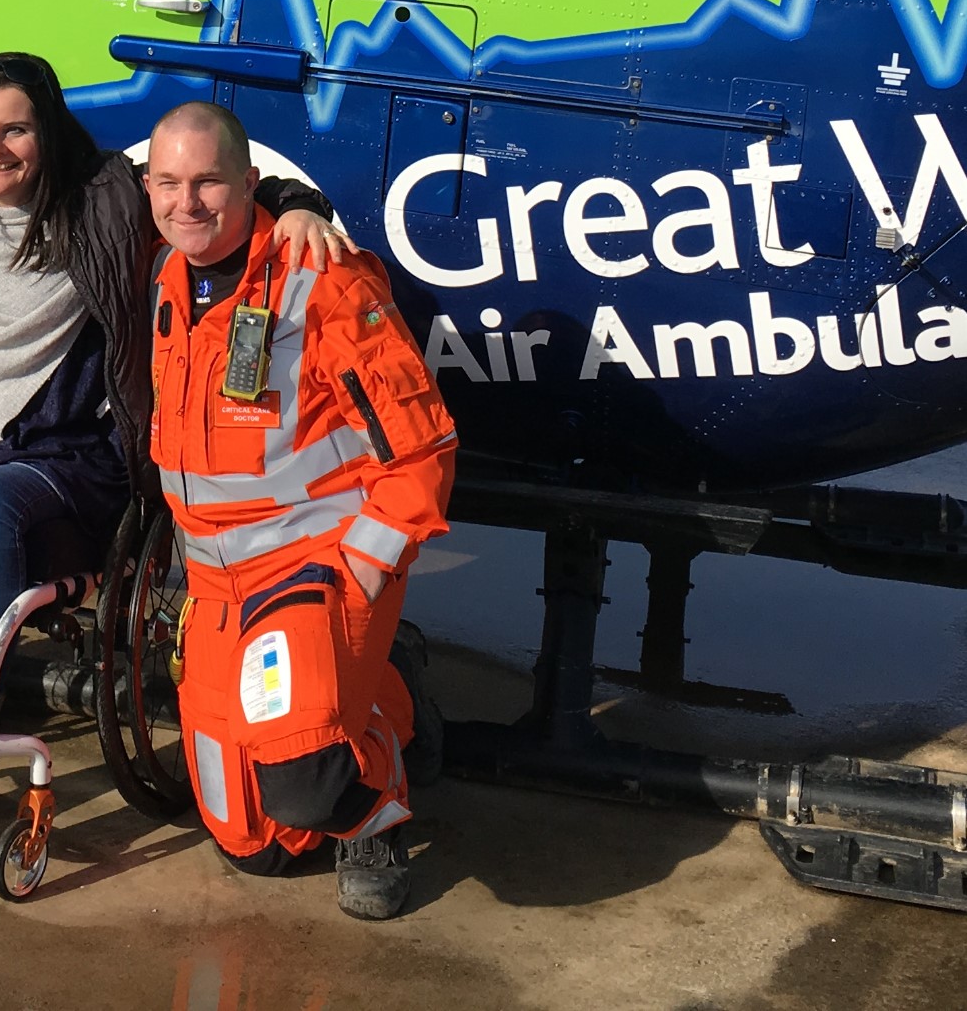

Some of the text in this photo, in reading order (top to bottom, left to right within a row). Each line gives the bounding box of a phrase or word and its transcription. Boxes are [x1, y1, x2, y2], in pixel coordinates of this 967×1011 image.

[384, 139, 816, 288] Great
[424, 283, 967, 382] Air Ambula
[221, 406, 252, 414] CRITICAL
